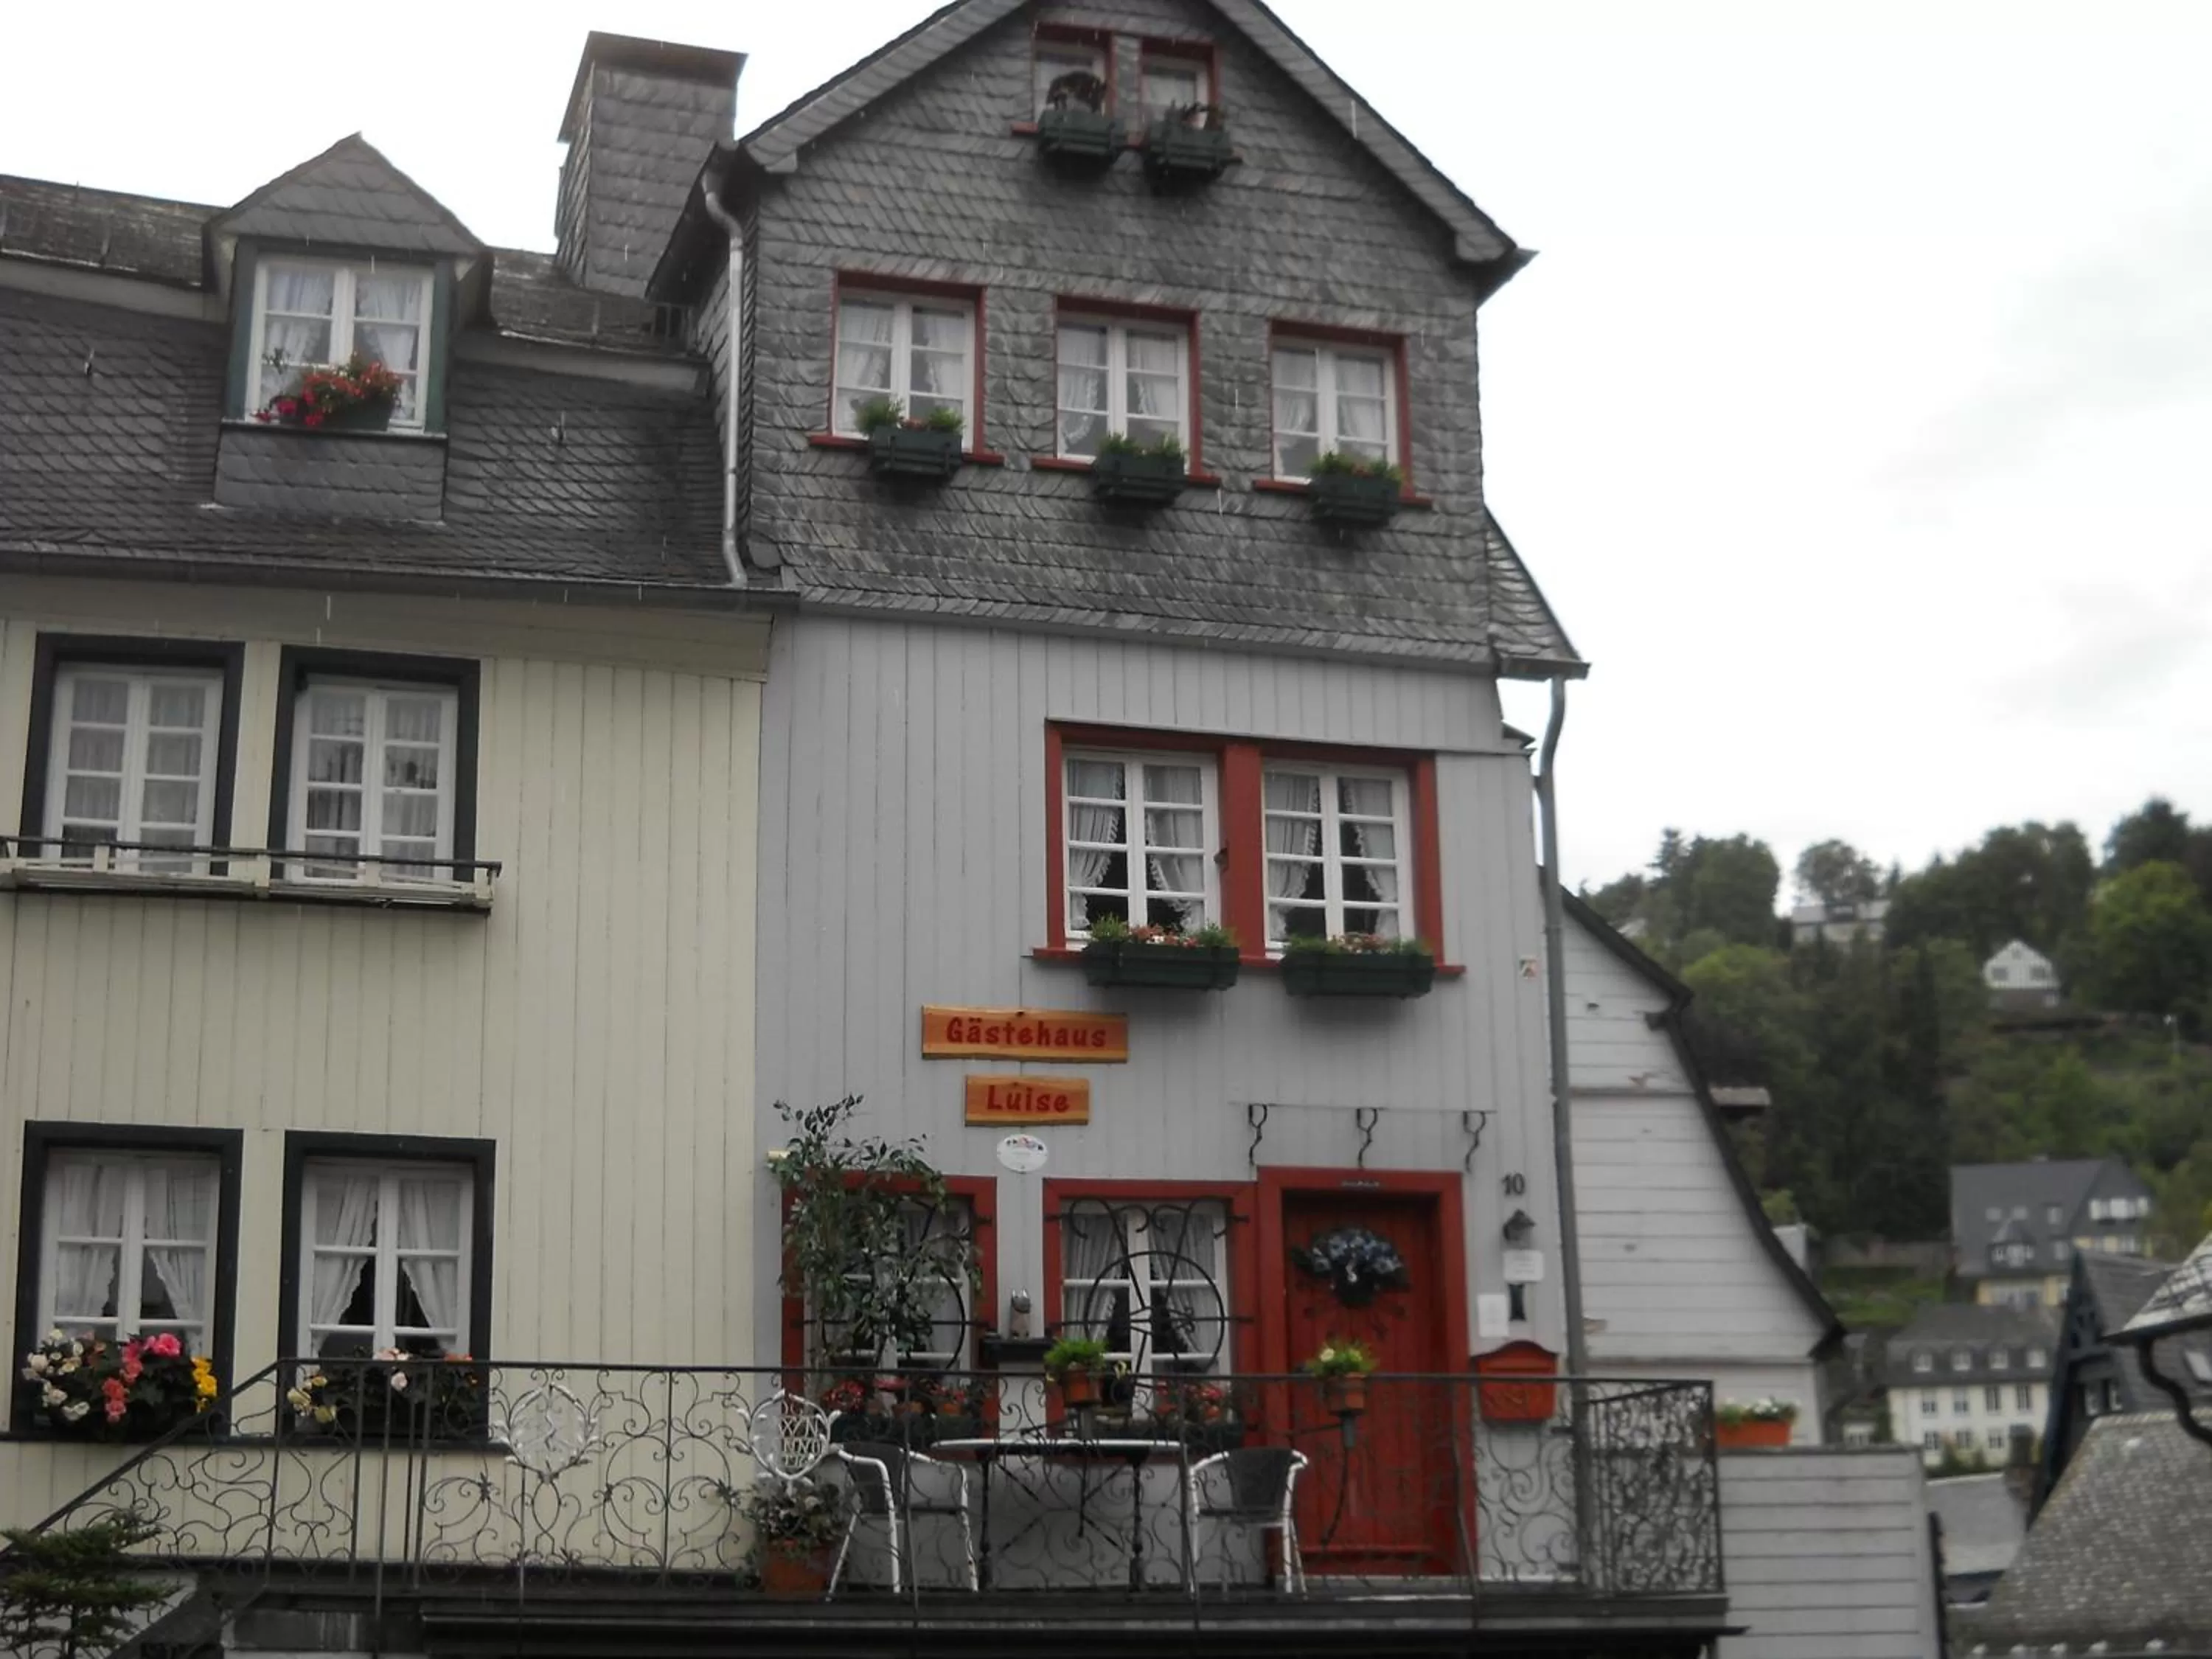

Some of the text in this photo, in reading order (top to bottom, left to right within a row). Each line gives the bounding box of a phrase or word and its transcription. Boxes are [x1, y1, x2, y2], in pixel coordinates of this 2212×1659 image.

[945, 1016, 1107, 1048] Gästehaus
[987, 1084, 1071, 1113] Luise
[1501, 1172, 1526, 1196] 10
